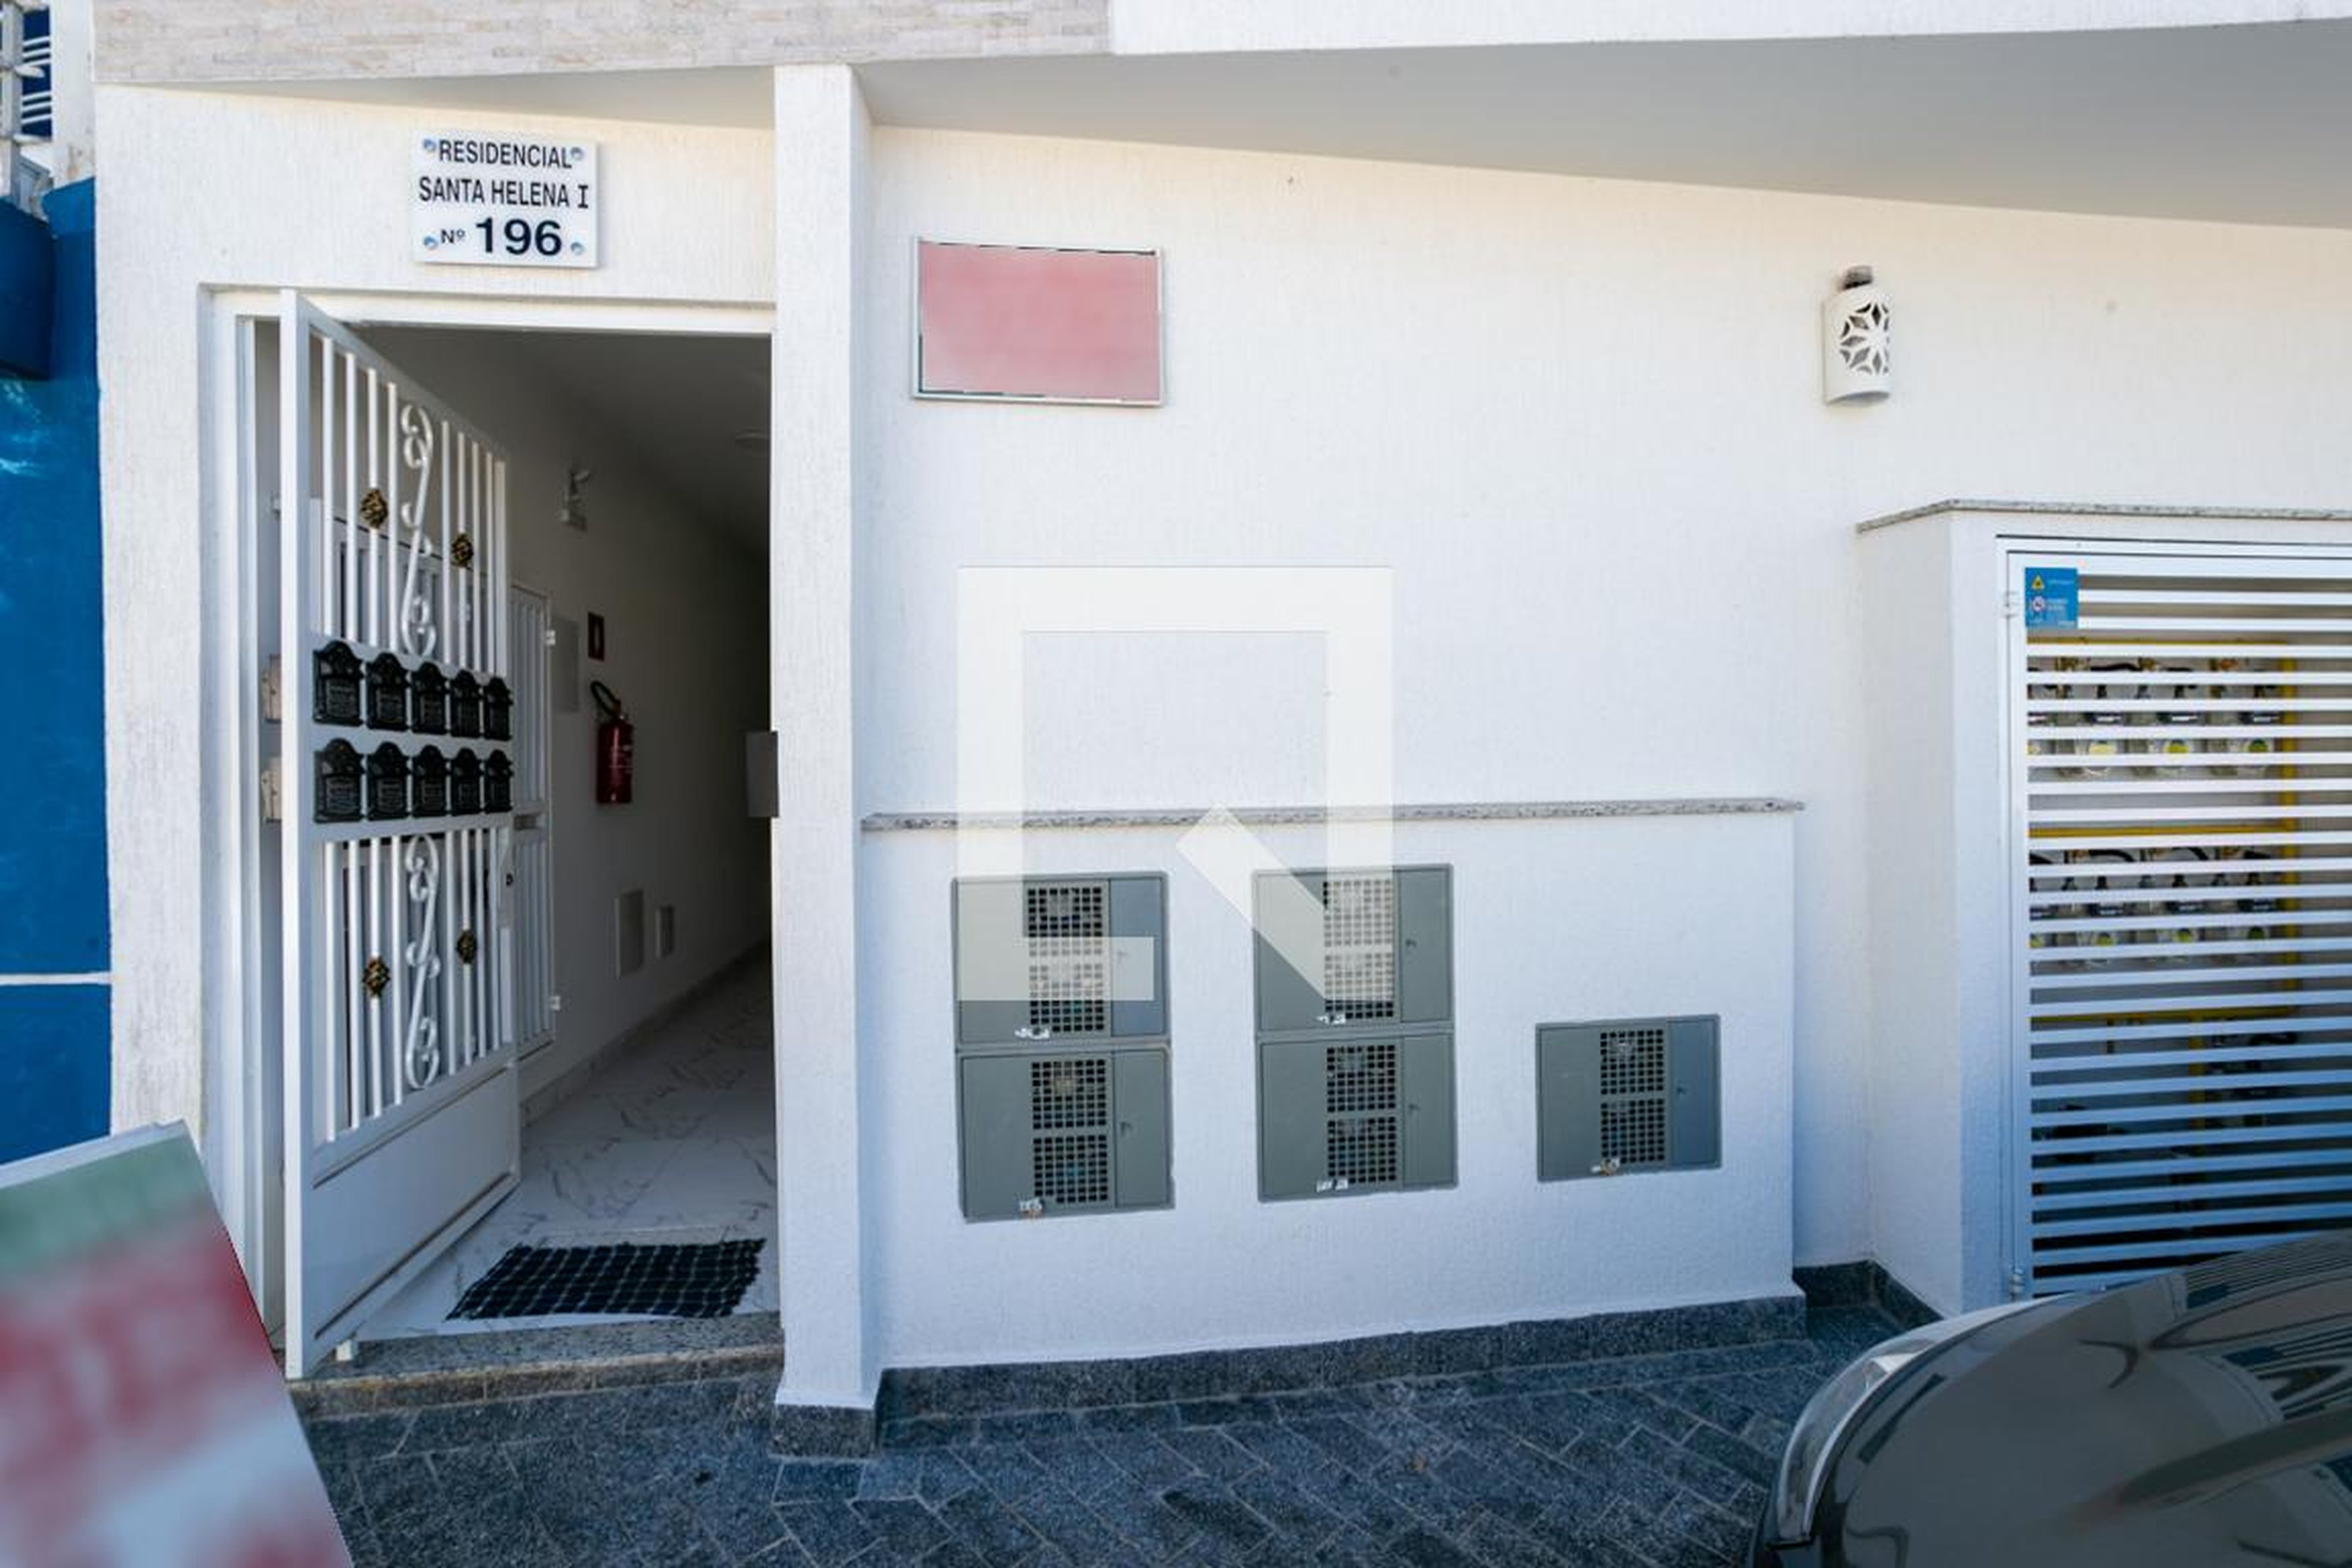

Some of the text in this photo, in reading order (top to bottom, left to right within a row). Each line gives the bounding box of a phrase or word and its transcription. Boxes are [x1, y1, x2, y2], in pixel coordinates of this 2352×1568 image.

[439, 140, 572, 168] RESIDENCIAL
[419, 176, 589, 209] SANTA HELENA I
[475, 216, 562, 256] 196
